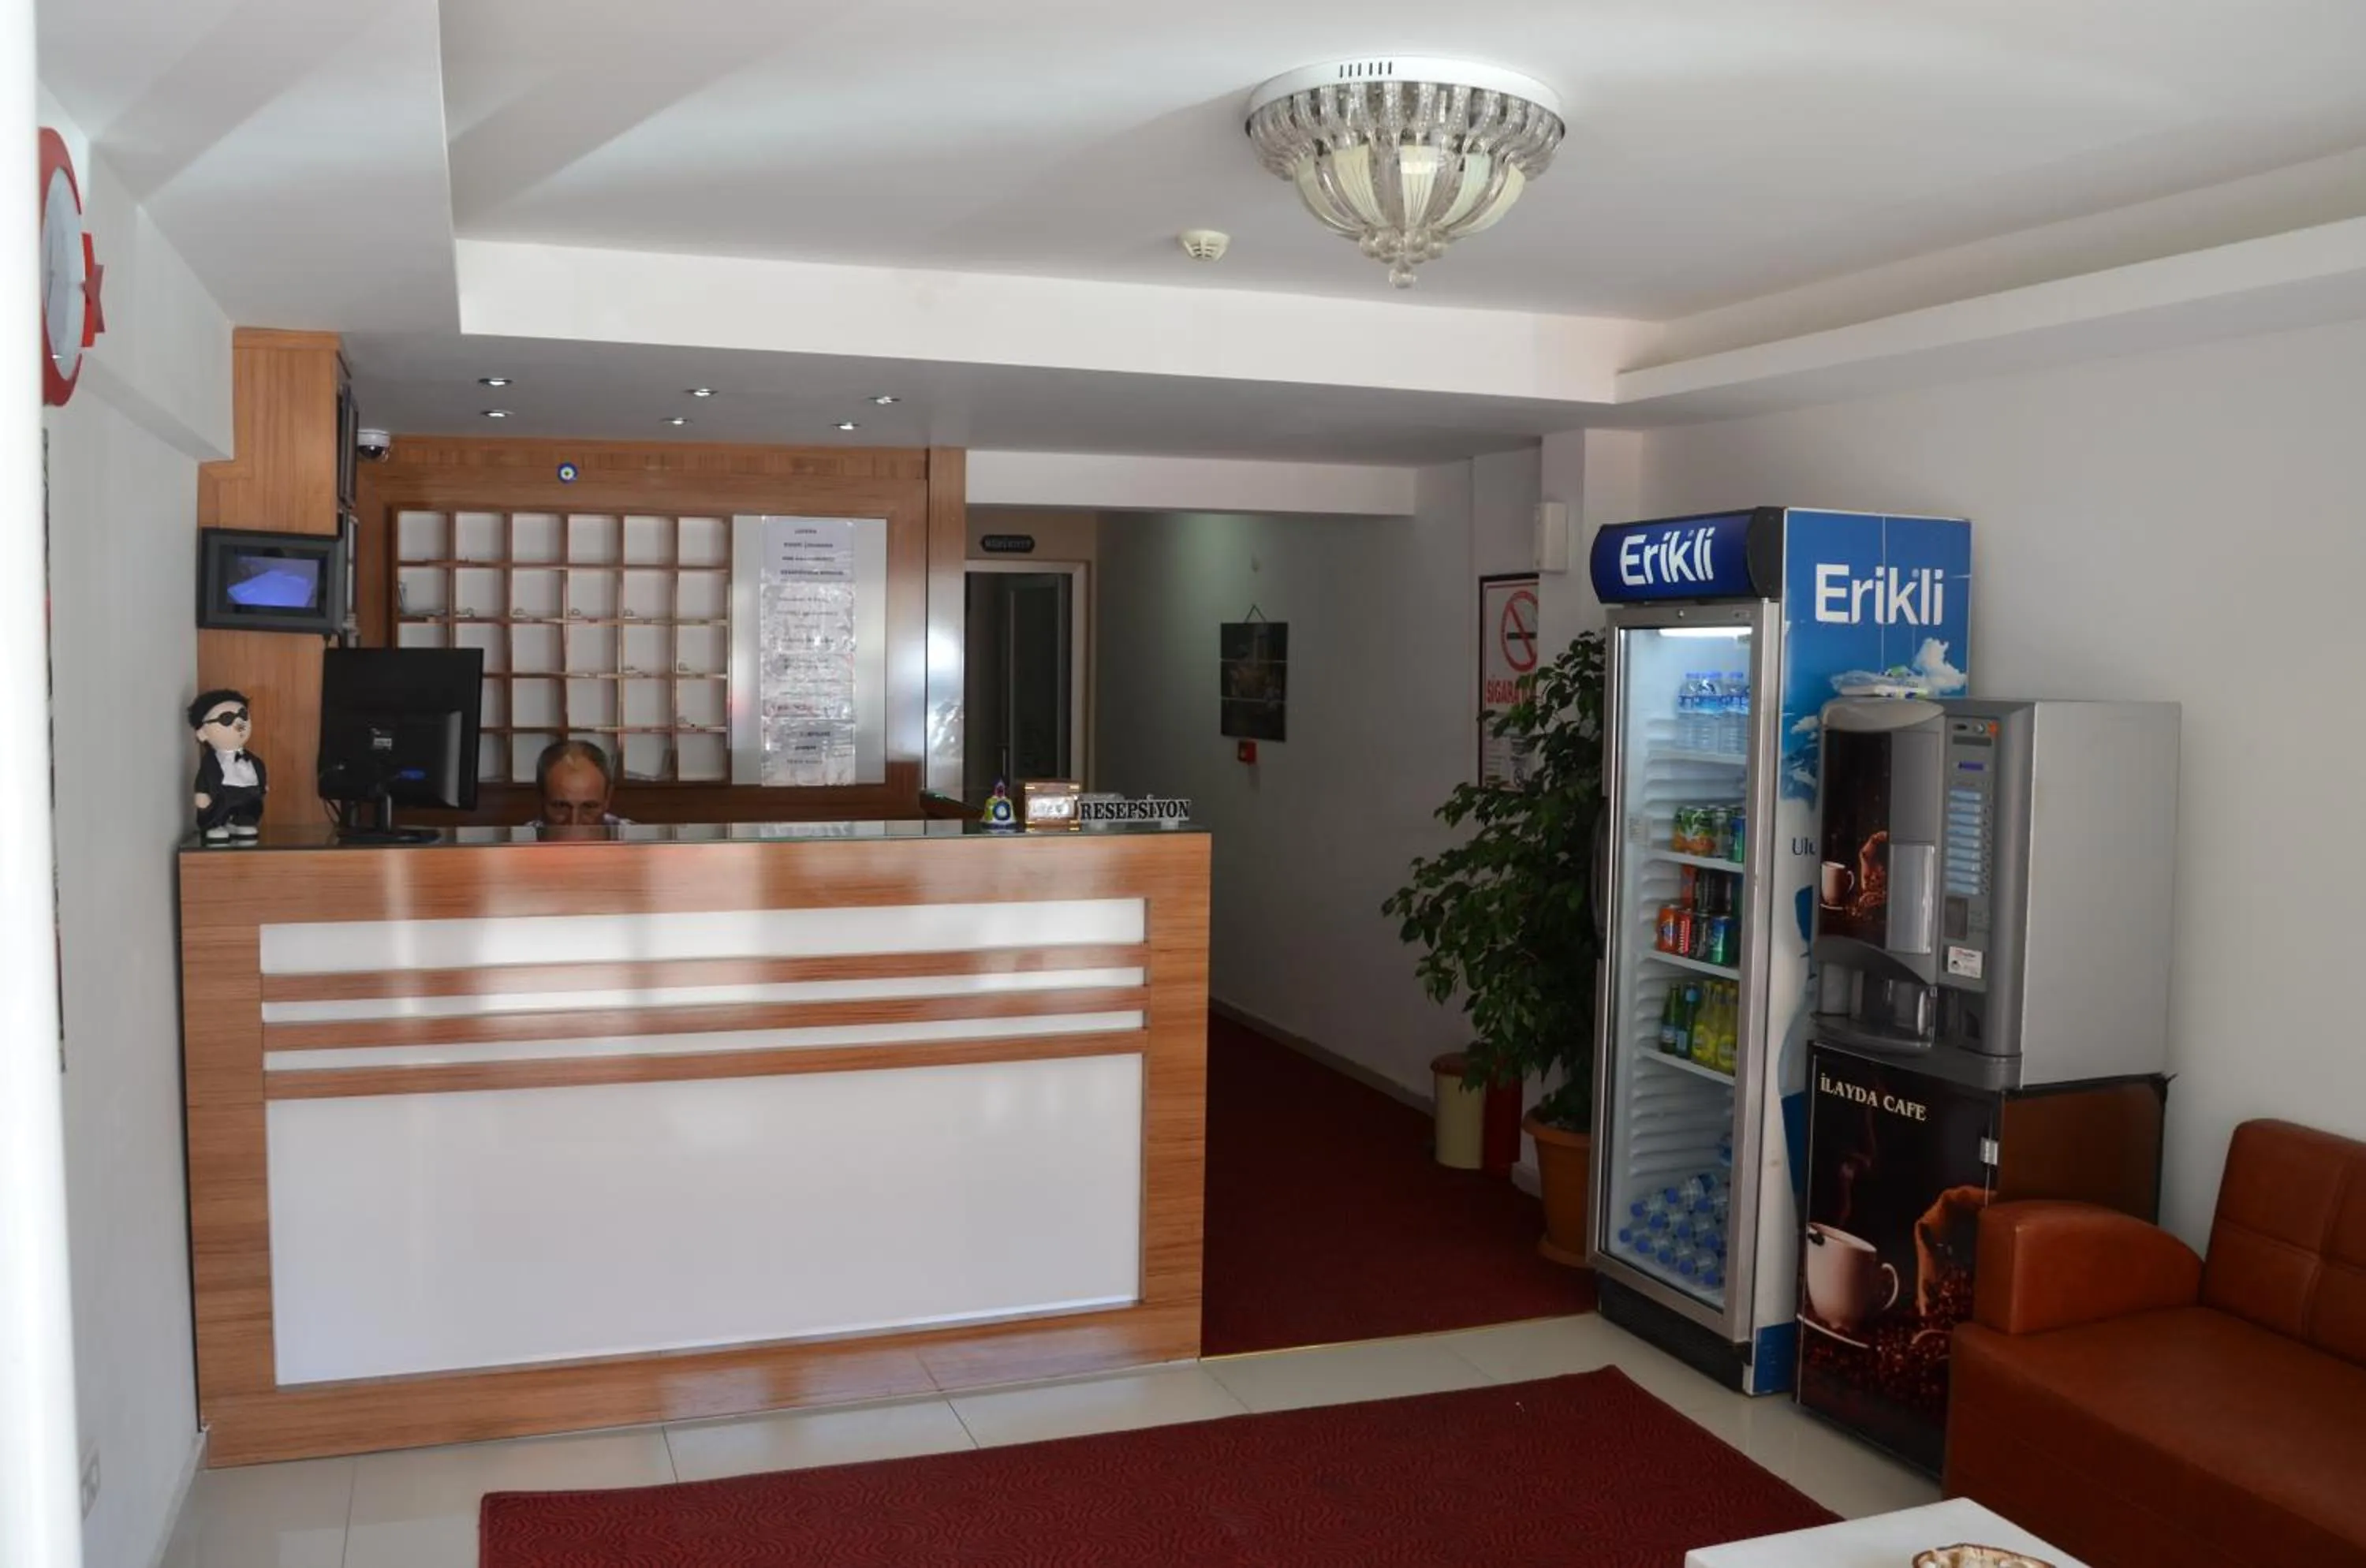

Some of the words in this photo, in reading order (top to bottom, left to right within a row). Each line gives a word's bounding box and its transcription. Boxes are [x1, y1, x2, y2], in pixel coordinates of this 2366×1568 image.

[1618, 526, 1716, 586] Erikli
[1815, 562, 1944, 626] Erikli
[1819, 1072, 1879, 1107] İLAYDA
[1883, 1095, 1928, 1122] CAFE
